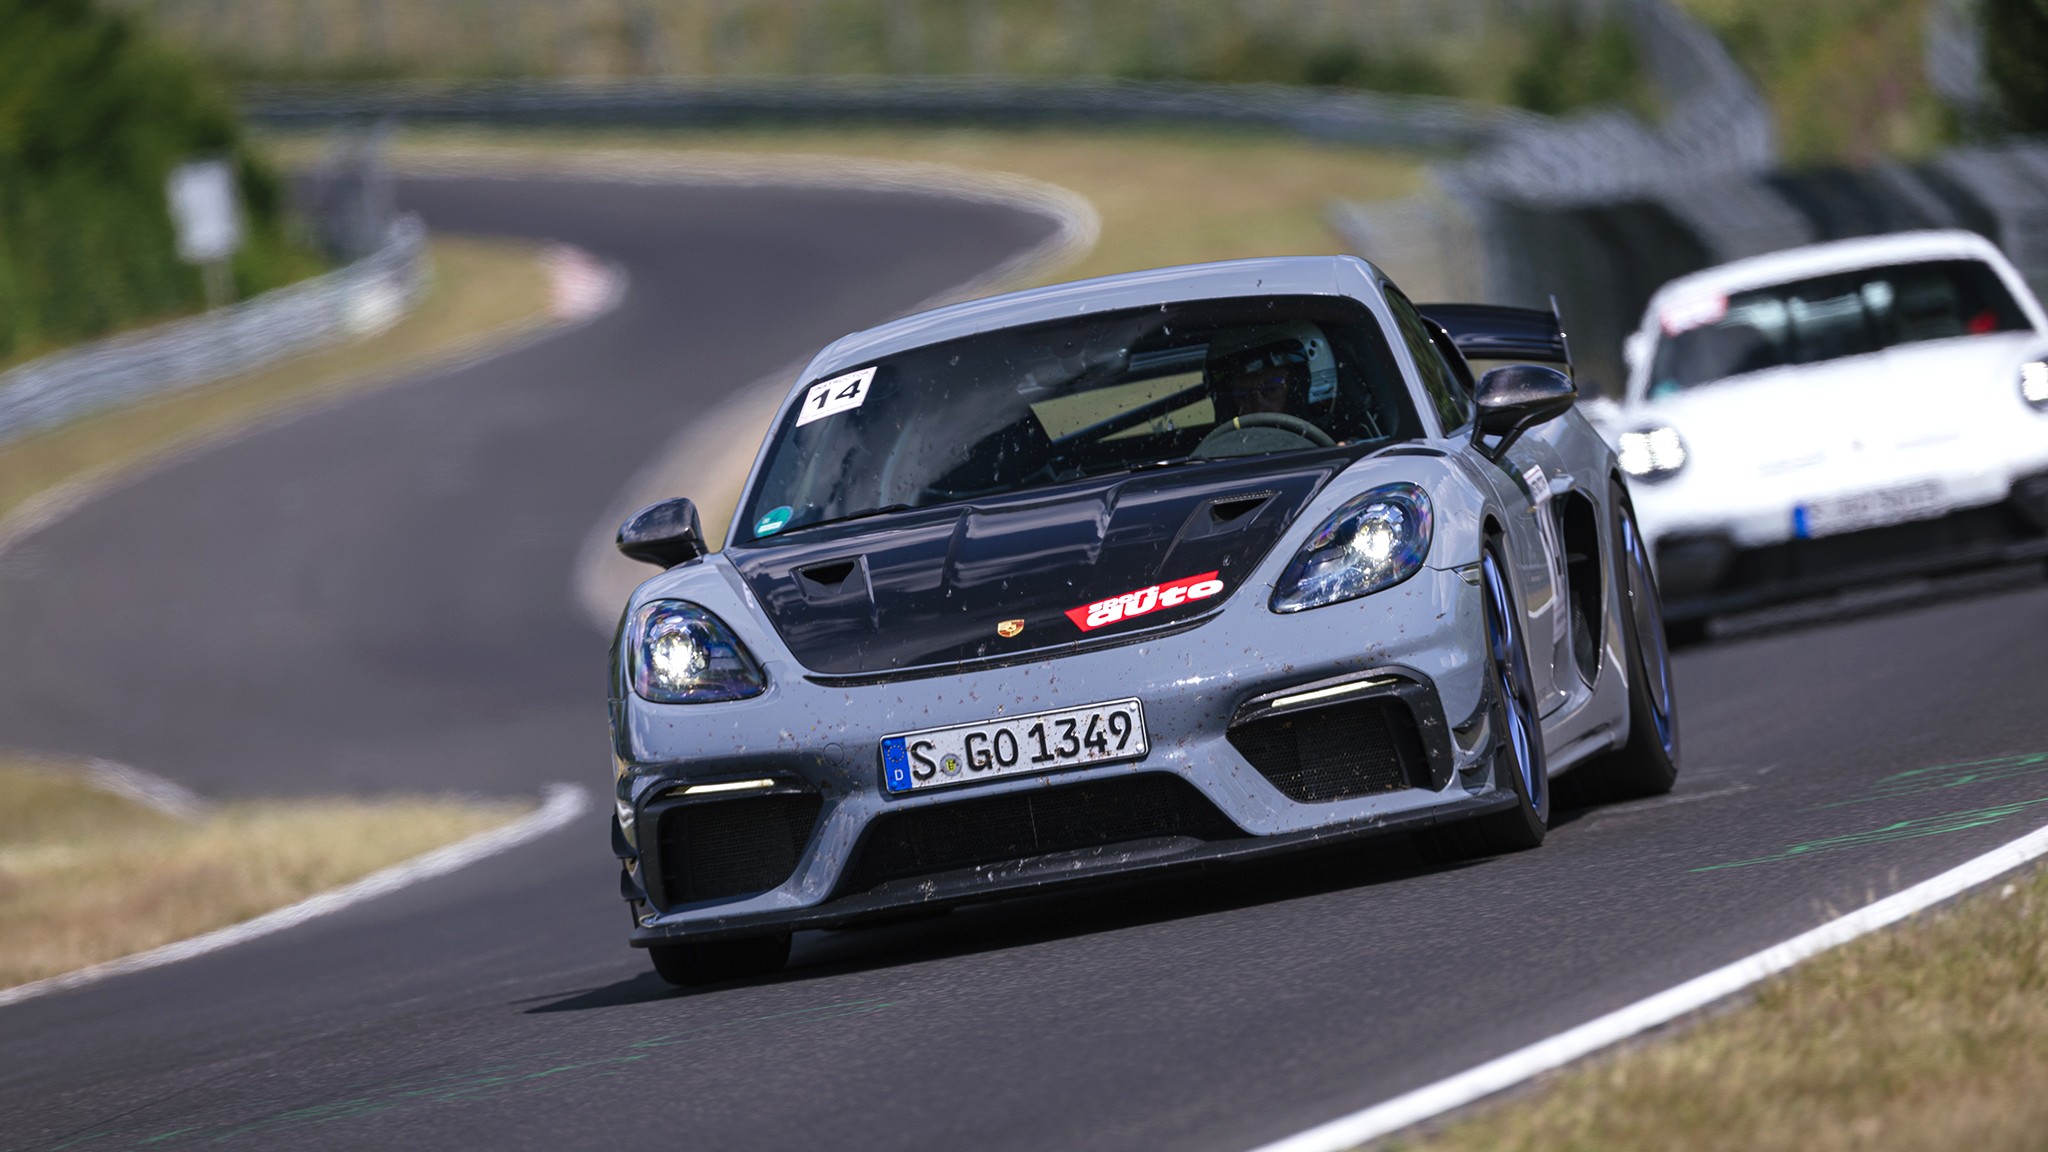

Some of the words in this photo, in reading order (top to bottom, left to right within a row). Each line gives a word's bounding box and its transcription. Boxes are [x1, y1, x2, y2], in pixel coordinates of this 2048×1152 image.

[812, 379, 861, 410] 14
[1086, 579, 1224, 627] auto
[911, 740, 937, 781] S
[964, 728, 1019, 772] GO
[1028, 711, 1132, 764] 1349
[894, 769, 904, 781] D
